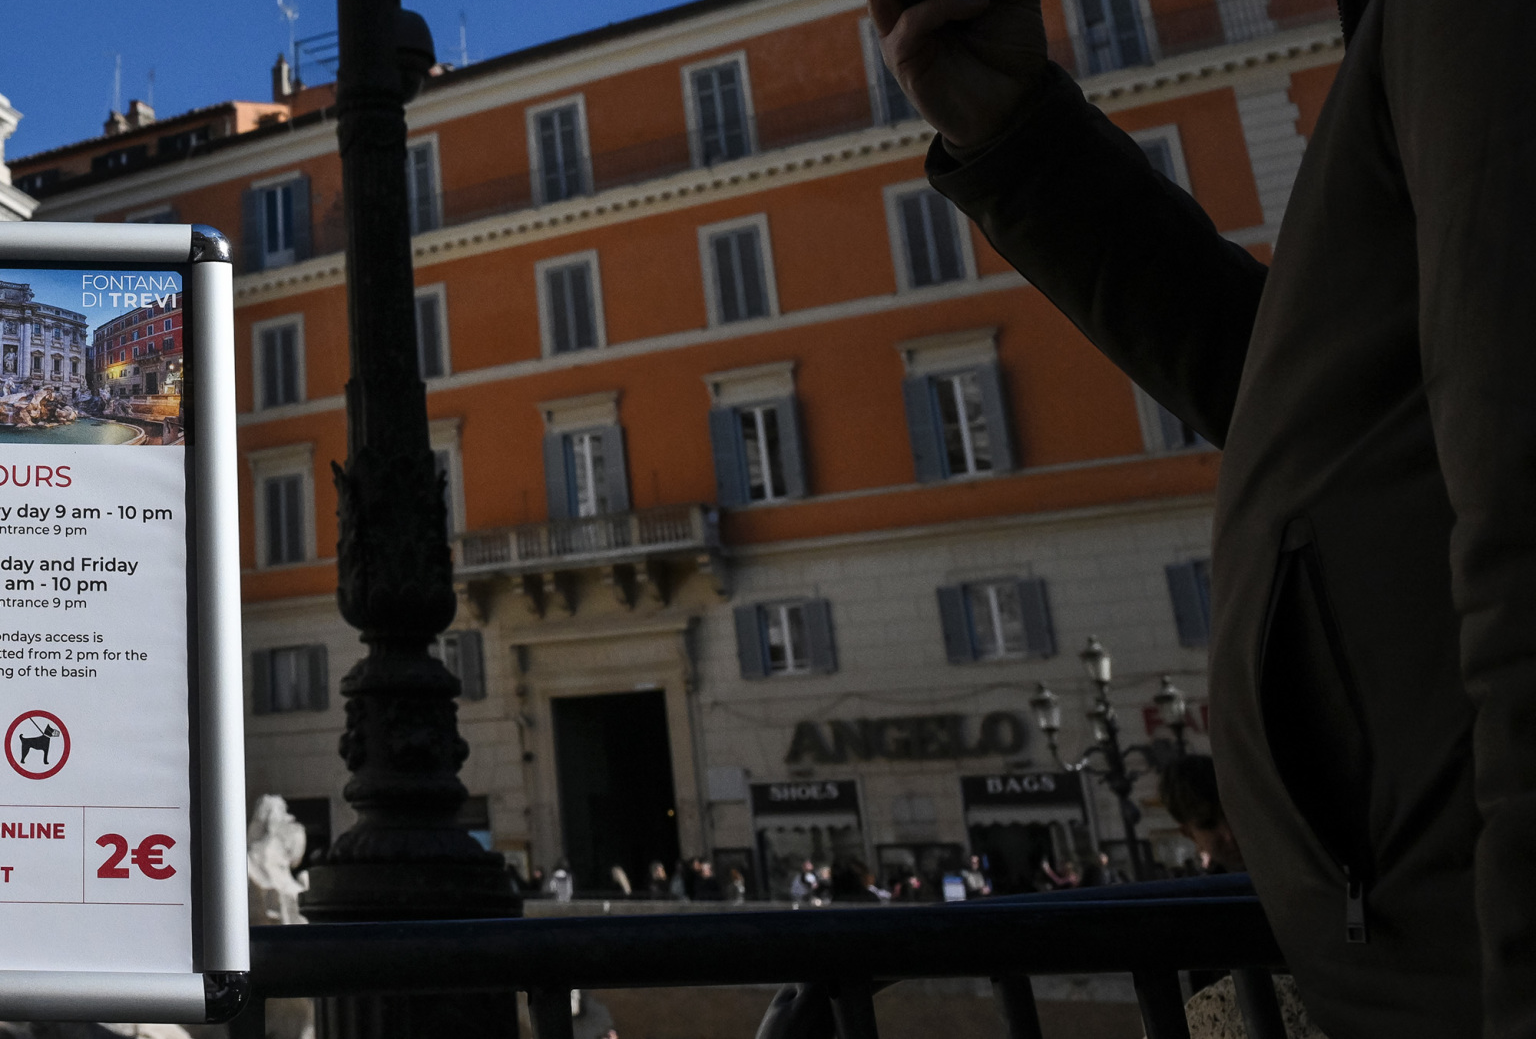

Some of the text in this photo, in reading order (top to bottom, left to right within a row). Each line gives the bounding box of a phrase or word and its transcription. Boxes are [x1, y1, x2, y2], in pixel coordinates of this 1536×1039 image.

[82, 275, 177, 290] FONTANA
[82, 292, 176, 308] DI TREVI
[17, 503, 50, 522] day
[55, 505, 66, 518] 9
[72, 508, 100, 519] am
[118, 506, 137, 519] 10
[143, 509, 172, 523] pm
[53, 525, 61, 535] 9
[65, 527, 87, 537] pm
[40, 557, 74, 571] and
[82, 557, 138, 576] Friday
[5, 579, 34, 590] am
[52, 577, 71, 591] 10
[77, 580, 107, 595] pm
[53, 597, 61, 608] 9
[65, 600, 87, 610] pm
[45, 634, 89, 643] access
[93, 631, 103, 643] is
[28, 648, 61, 659] from
[65, 649, 73, 660] 2
[77, 651, 99, 662] pm
[103, 649, 121, 660] for
[125, 649, 148, 661] the
[18, 665, 32, 677] of
[34, 666, 57, 677] the
[62, 666, 97, 677] basin
[784, 712, 1027, 765] ANGELO
[986, 776, 1055, 794] BAGS
[95, 833, 177, 880] 2€
